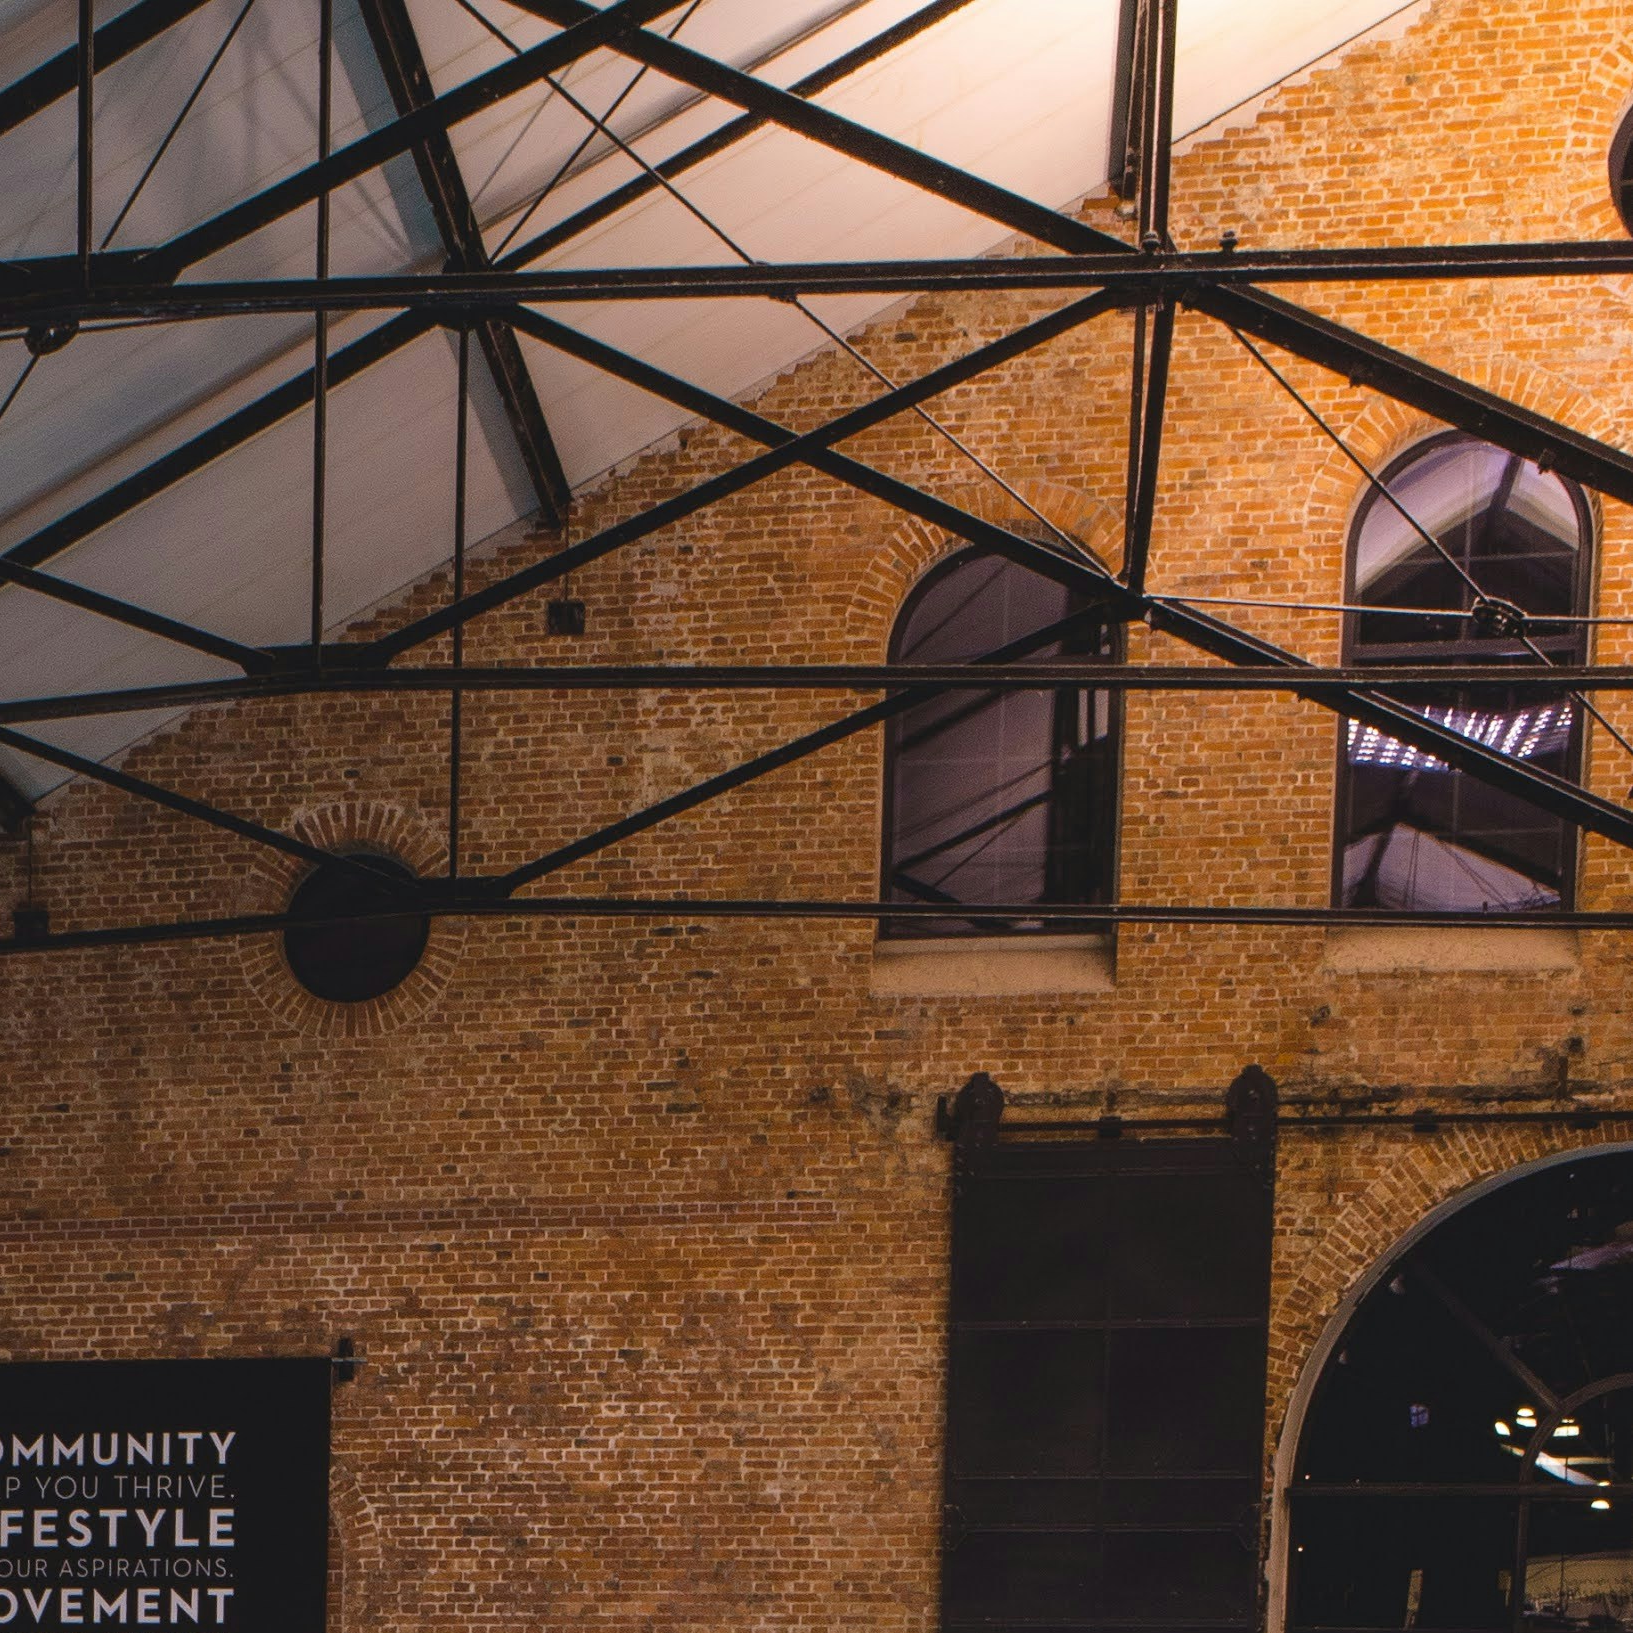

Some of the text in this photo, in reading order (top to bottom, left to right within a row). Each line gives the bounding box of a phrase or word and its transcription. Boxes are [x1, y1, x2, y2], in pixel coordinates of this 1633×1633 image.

[35, 1475, 98, 1500] YOU
[113, 1474, 235, 1499] THRIVE.
[59, 1557, 234, 1578] ASPIRATIONS.
